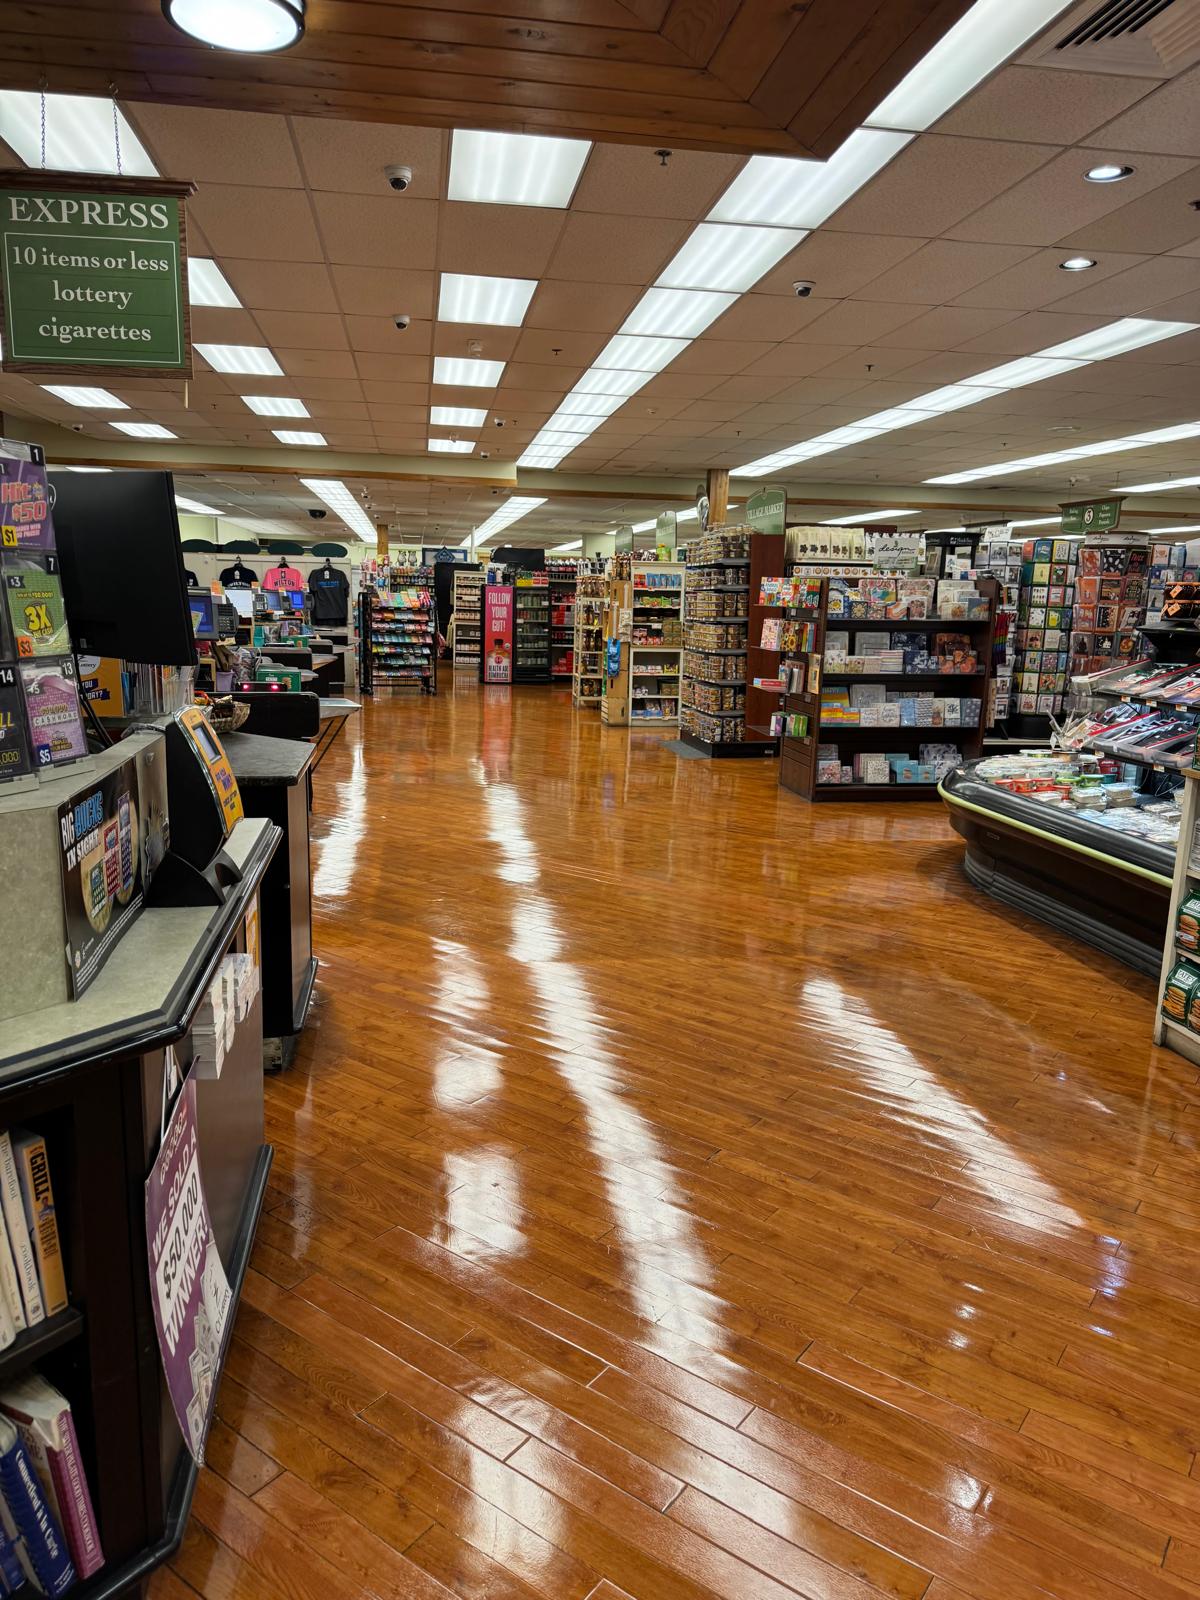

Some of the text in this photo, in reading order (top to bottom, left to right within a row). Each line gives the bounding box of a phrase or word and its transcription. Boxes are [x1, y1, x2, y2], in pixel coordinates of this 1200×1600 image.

[8, 197, 169, 229] EXPRESS
[13, 247, 169, 271] 10 items or less
[53, 280, 133, 310] lottery
[38, 317, 152, 343] cigarettes
[33, 448, 39, 461] 1
[765, 503, 784, 515] MARKET
[5, 529, 15, 543] $1
[48, 557, 55, 571] 7
[274, 579, 296, 587] WILTON
[488, 592, 511, 605] FOLLOW
[24, 604, 52, 631] 3X
[492, 606, 508, 618] YOUR
[492, 620, 506, 632] GUT!
[0, 669, 14, 684] 14
[62, 662, 73, 676] 13
[39, 749, 51, 763] $5
[61, 791, 104, 850] BIG BUCKS
[66, 828, 99, 872] IN SIGHT
[5, 1156, 19, 1200] barefoot
[30, 1151, 50, 1201] GRILL
[152, 1207, 168, 1264] WE
[168, 1142, 190, 1217] SOLD
[190, 1124, 198, 1153] A
[162, 1171, 198, 1299] $50,000
[165, 1204, 209, 1358] WINNER!
[15, 1449, 40, 1508] Connecticut
